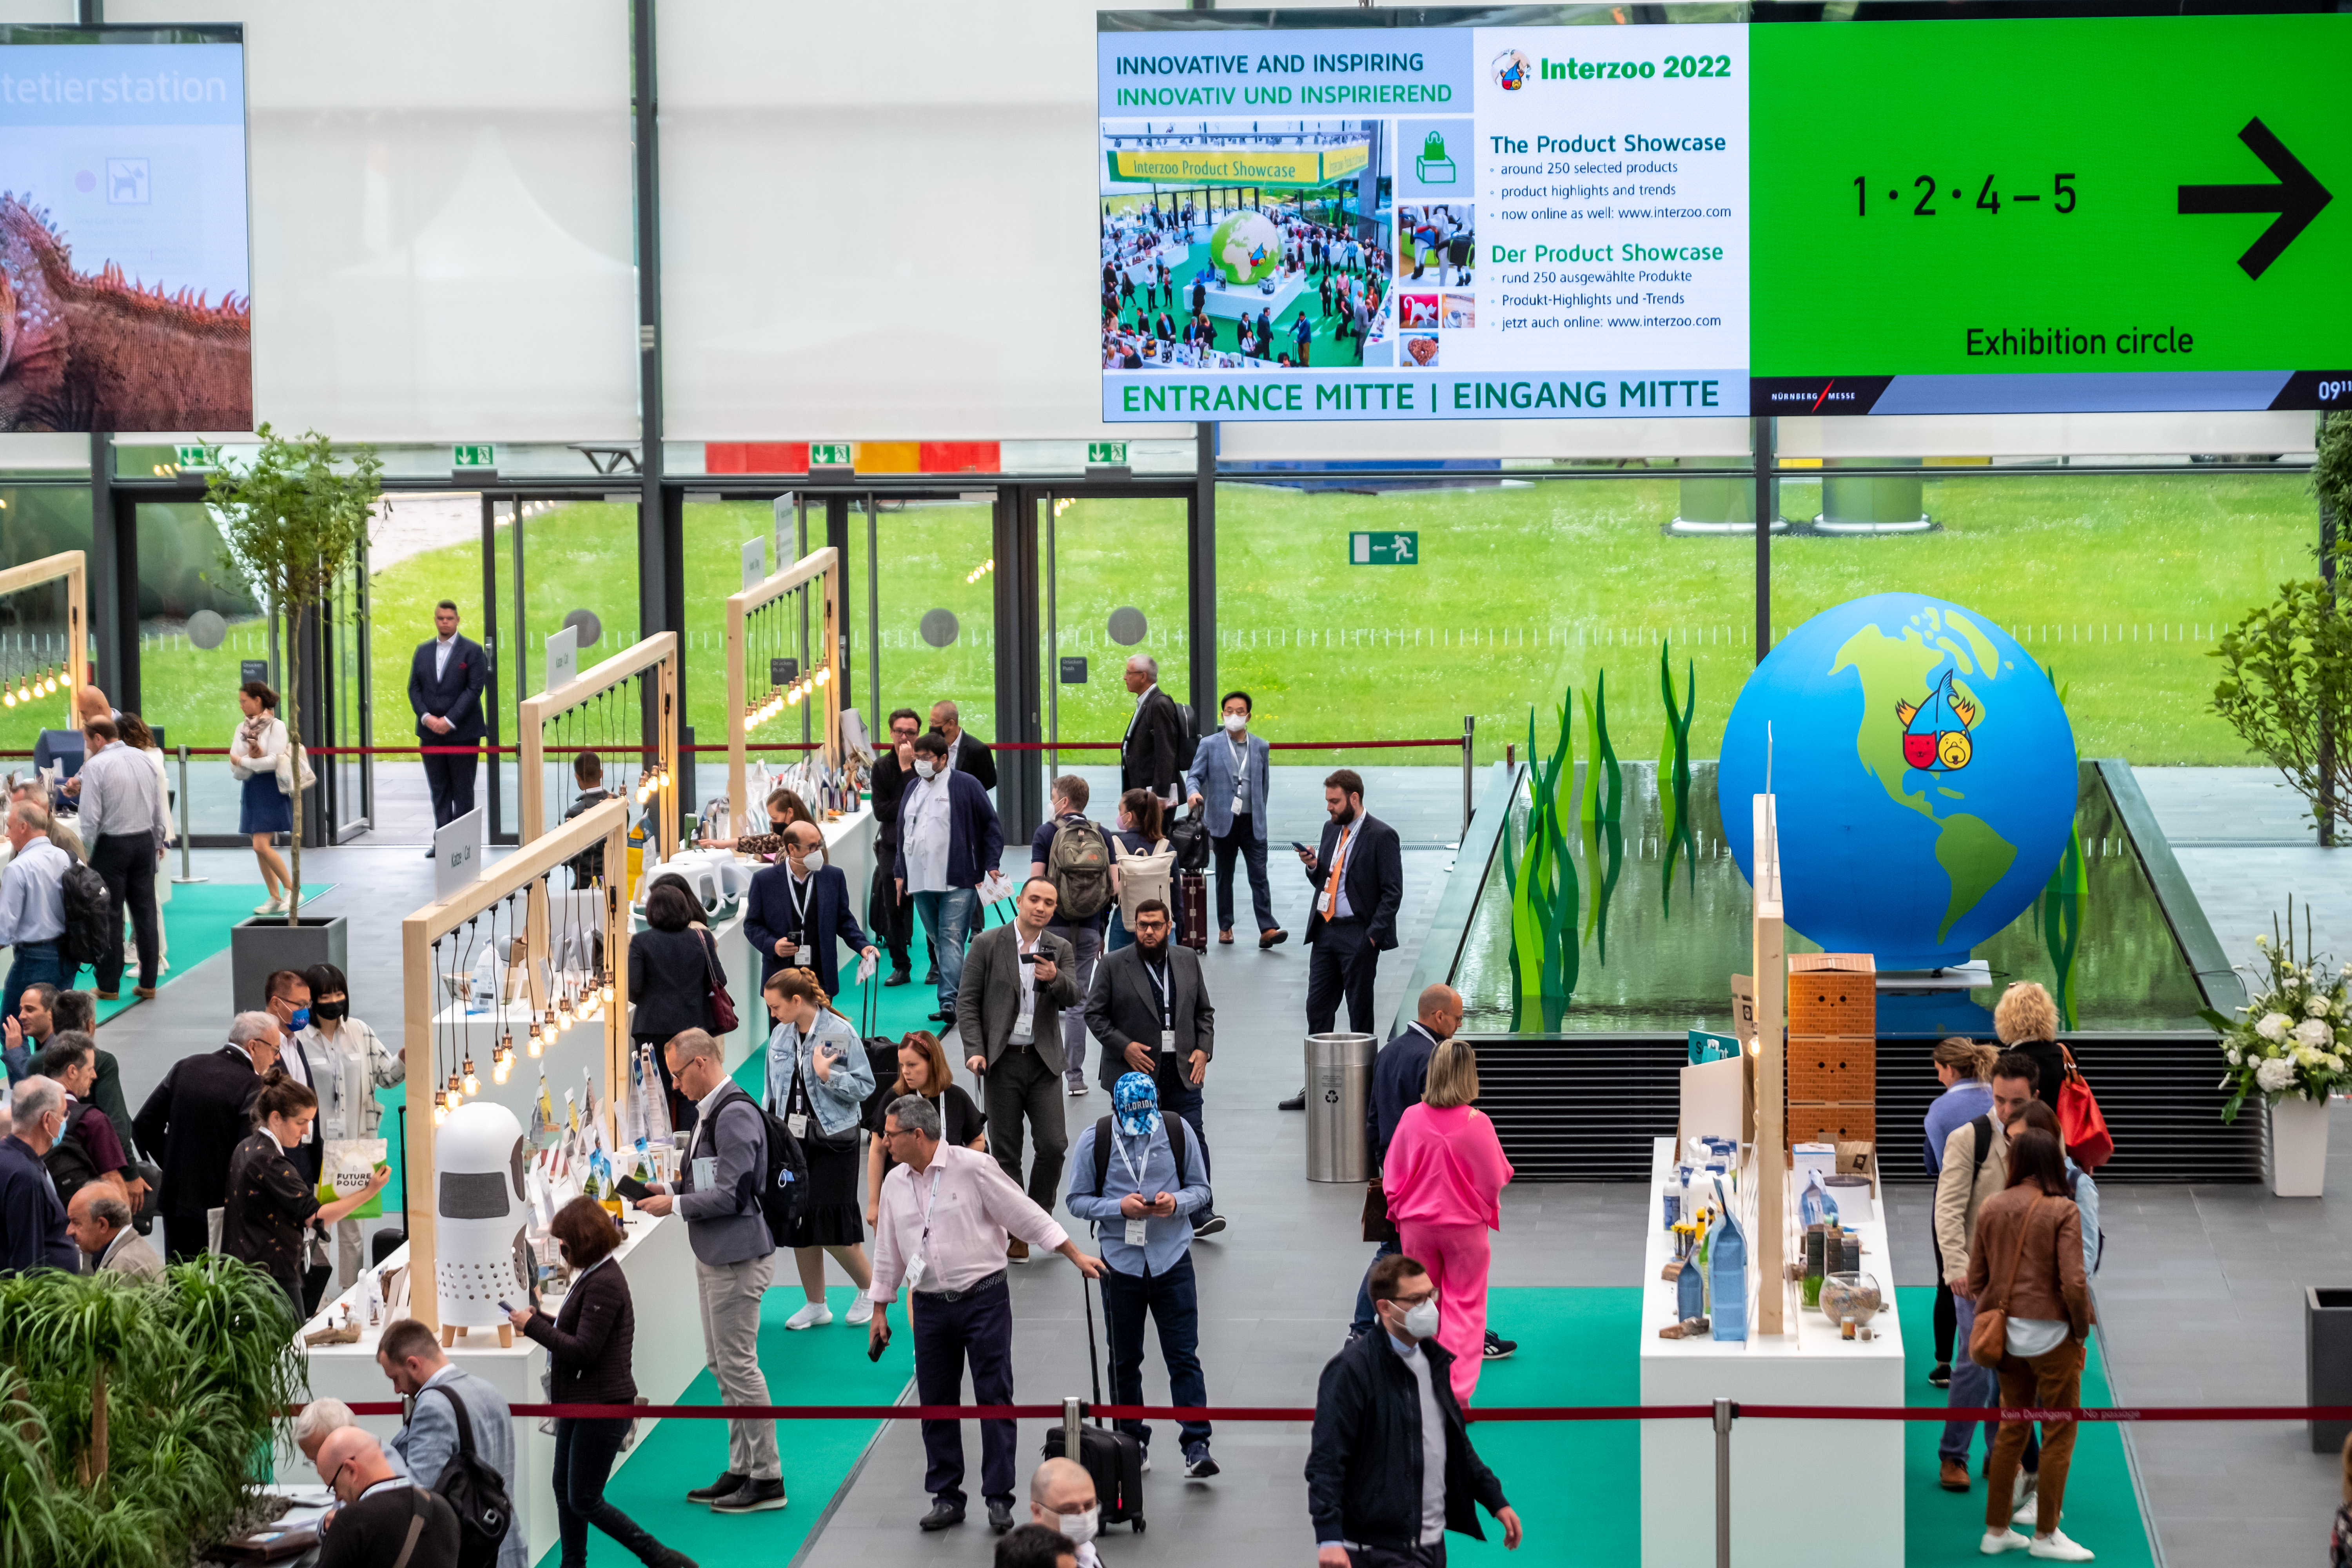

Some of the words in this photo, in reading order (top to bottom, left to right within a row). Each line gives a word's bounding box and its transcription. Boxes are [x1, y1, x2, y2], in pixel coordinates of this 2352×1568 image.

[1117, 55, 1248, 74] INNOVATIVE
[1257, 55, 1305, 73] AND
[1314, 53, 1423, 72] INSPIRING
[1542, 58, 1655, 80] Interzoo
[1663, 55, 1730, 78] 2022
[1118, 87, 1235, 105] INNOVATIV
[1245, 86, 1292, 104] UND
[1301, 84, 1451, 103] INSPIRIEREND
[1490, 136, 1528, 153] The
[1538, 134, 1615, 152] Product
[1624, 134, 1726, 152] Showcase
[1133, 161, 1178, 175] Interzoo
[1183, 160, 1227, 176] Product
[1233, 161, 1295, 178] Showcase
[1501, 163, 1542, 174] around
[1548, 163, 1570, 174] 250
[1574, 161, 1622, 173] selected
[1627, 161, 1677, 176] products
[1502, 185, 1547, 200] product
[1552, 184, 1608, 199] highlights
[1613, 184, 1634, 196] and
[1639, 183, 1675, 195] trends
[1854, 176, 1865, 216] 1
[1914, 175, 1936, 215] 2
[1976, 174, 2000, 214] 4
[2054, 173, 2076, 214] 5
[1502, 211, 1527, 220] now
[1532, 207, 1567, 219] online
[1571, 210, 1583, 219] as
[1587, 207, 1613, 218] well:
[1618, 207, 1731, 218] www.interzoo.com
[1492, 245, 1526, 263] Der
[1535, 244, 1613, 262] Product
[1622, 243, 1723, 261] Showcase
[1503, 272, 1528, 283] rund
[1534, 272, 1556, 283] 250
[1560, 271, 1635, 285] ausgewählte
[1639, 270, 1692, 281] Produkte
[1503, 293, 1611, 308] Produkt-Highlights
[1617, 293, 1638, 304] und
[1643, 292, 1684, 304] -Trends
[1502, 316, 1527, 331] jetzt
[1532, 317, 1559, 328] auch
[1564, 316, 1602, 327] online:
[1608, 317, 1720, 327] www.interzoo.com
[1967, 327, 2105, 356] Exhibition
[2116, 326, 2193, 354] circle
[1123, 384, 1302, 412] ENTRANCE
[1316, 383, 1414, 410] MITTE
[1454, 381, 1606, 408] EINGANG
[1621, 380, 1719, 407] MITTE
[451, 851, 462, 867] Katze
[1124, 1099, 1153, 1113] FLORIDA
[2000, 1409, 2021, 1419] Kein
[2023, 1408, 2073, 1421] Durchgang
[2083, 1409, 2099, 1419] No
[2101, 1410, 2141, 1420] passage
